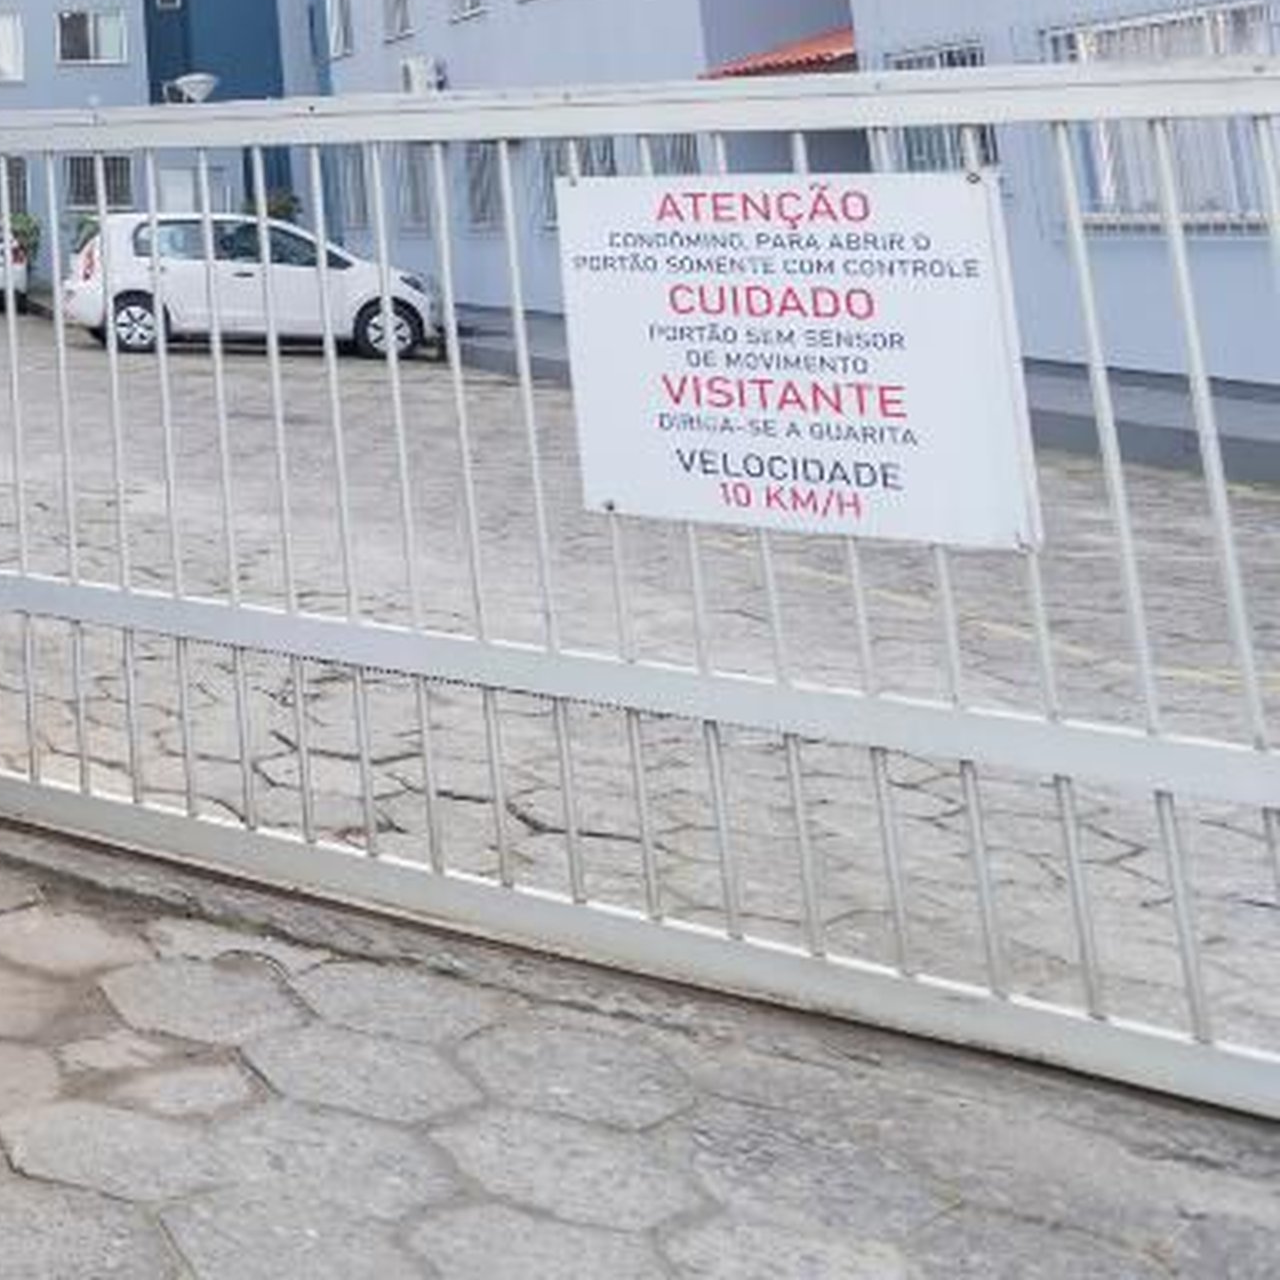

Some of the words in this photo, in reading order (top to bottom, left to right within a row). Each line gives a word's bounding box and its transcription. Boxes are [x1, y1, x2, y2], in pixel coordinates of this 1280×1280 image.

[655, 182, 871, 230] ATENÇÃO
[828, 233, 906, 252] ABRIR
[912, 232, 931, 252] O
[572, 253, 659, 272] PORTÃO
[665, 256, 776, 276] SOMENTE
[783, 259, 836, 276] COM
[842, 259, 981, 280] CONTROLE
[669, 284, 875, 321] CUIDADO
[648, 323, 739, 345] PORTÃO
[745, 326, 796, 347] SEM
[805, 329, 907, 351] SENSOR
[686, 349, 717, 369] DE
[725, 352, 870, 375] MOVIMENTO
[661, 374, 909, 419] VISITANTE
[809, 422, 919, 448] GUARITA
[676, 448, 905, 492] VELOCIDADE
[720, 482, 753, 509] 10
[764, 485, 864, 519] KM/H
